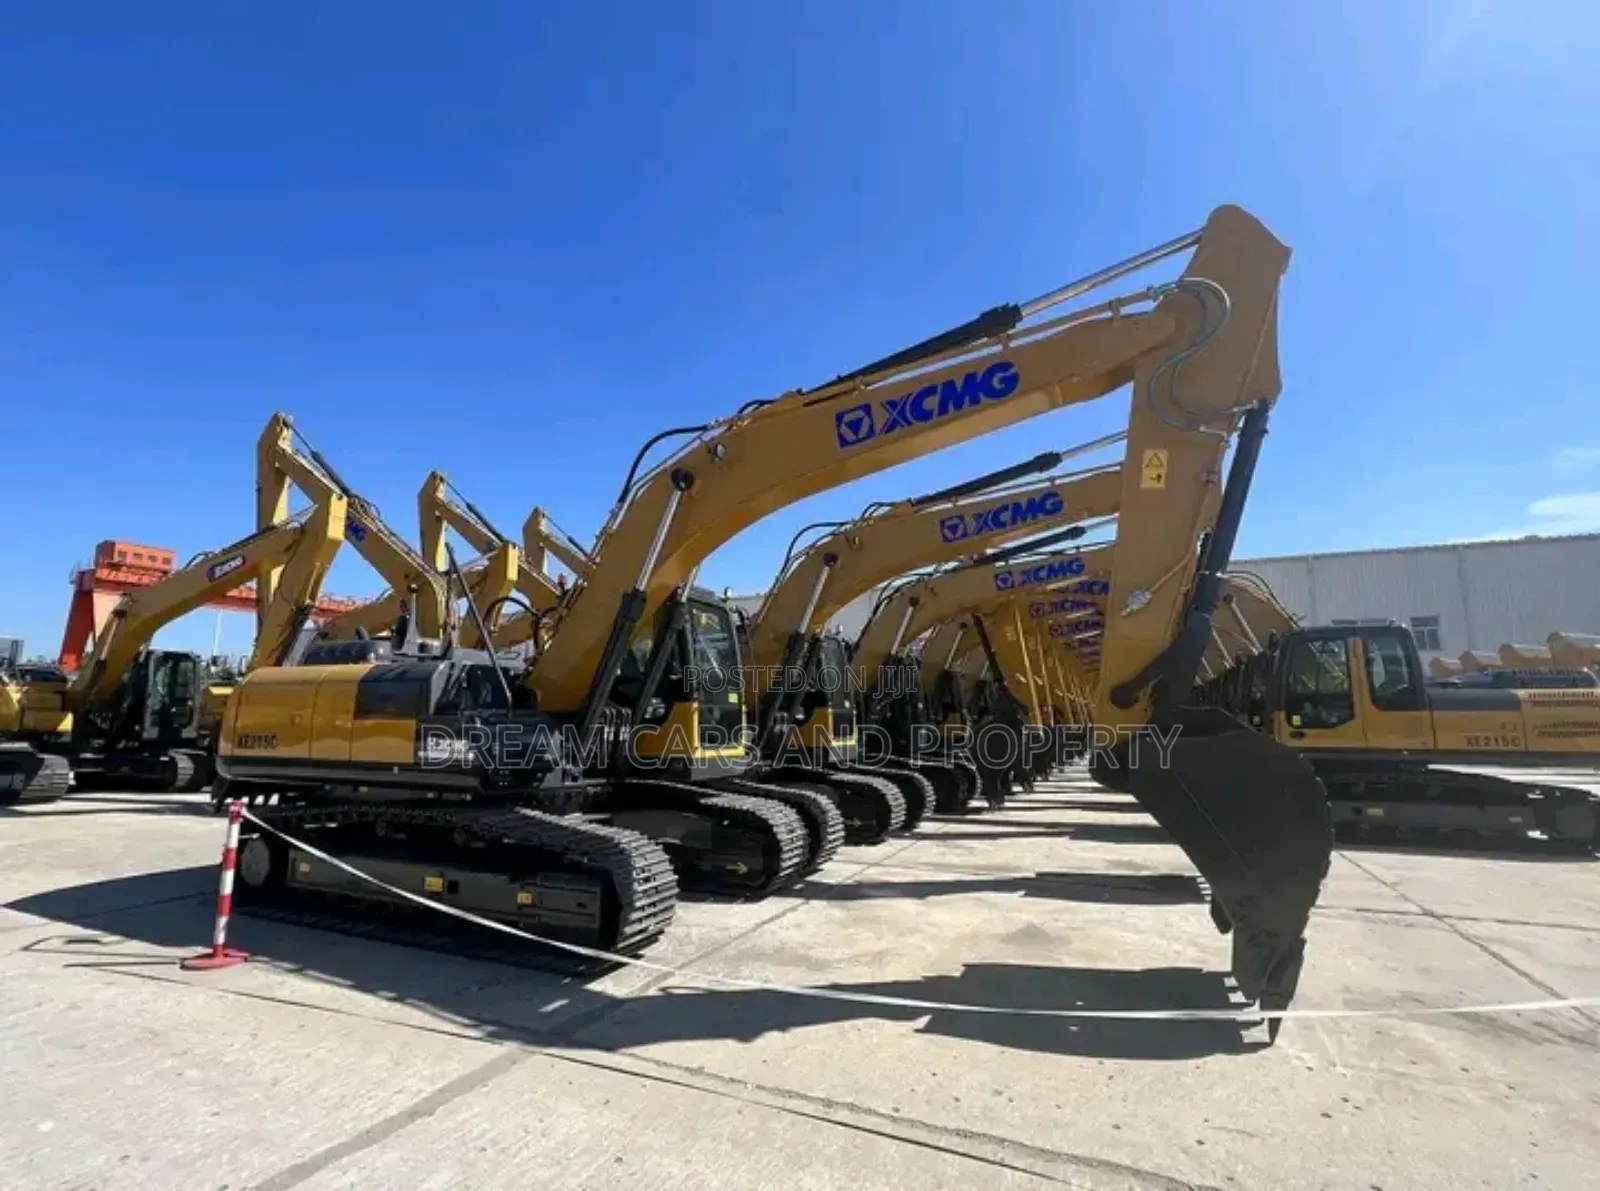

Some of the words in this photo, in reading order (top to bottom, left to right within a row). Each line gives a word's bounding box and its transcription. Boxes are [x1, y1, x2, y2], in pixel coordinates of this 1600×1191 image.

[878, 361, 1020, 436] XCMG
[971, 490, 1064, 536] XCMG
[1018, 557, 1085, 586] XCMG
[1464, 734, 1521, 748] XE215C
